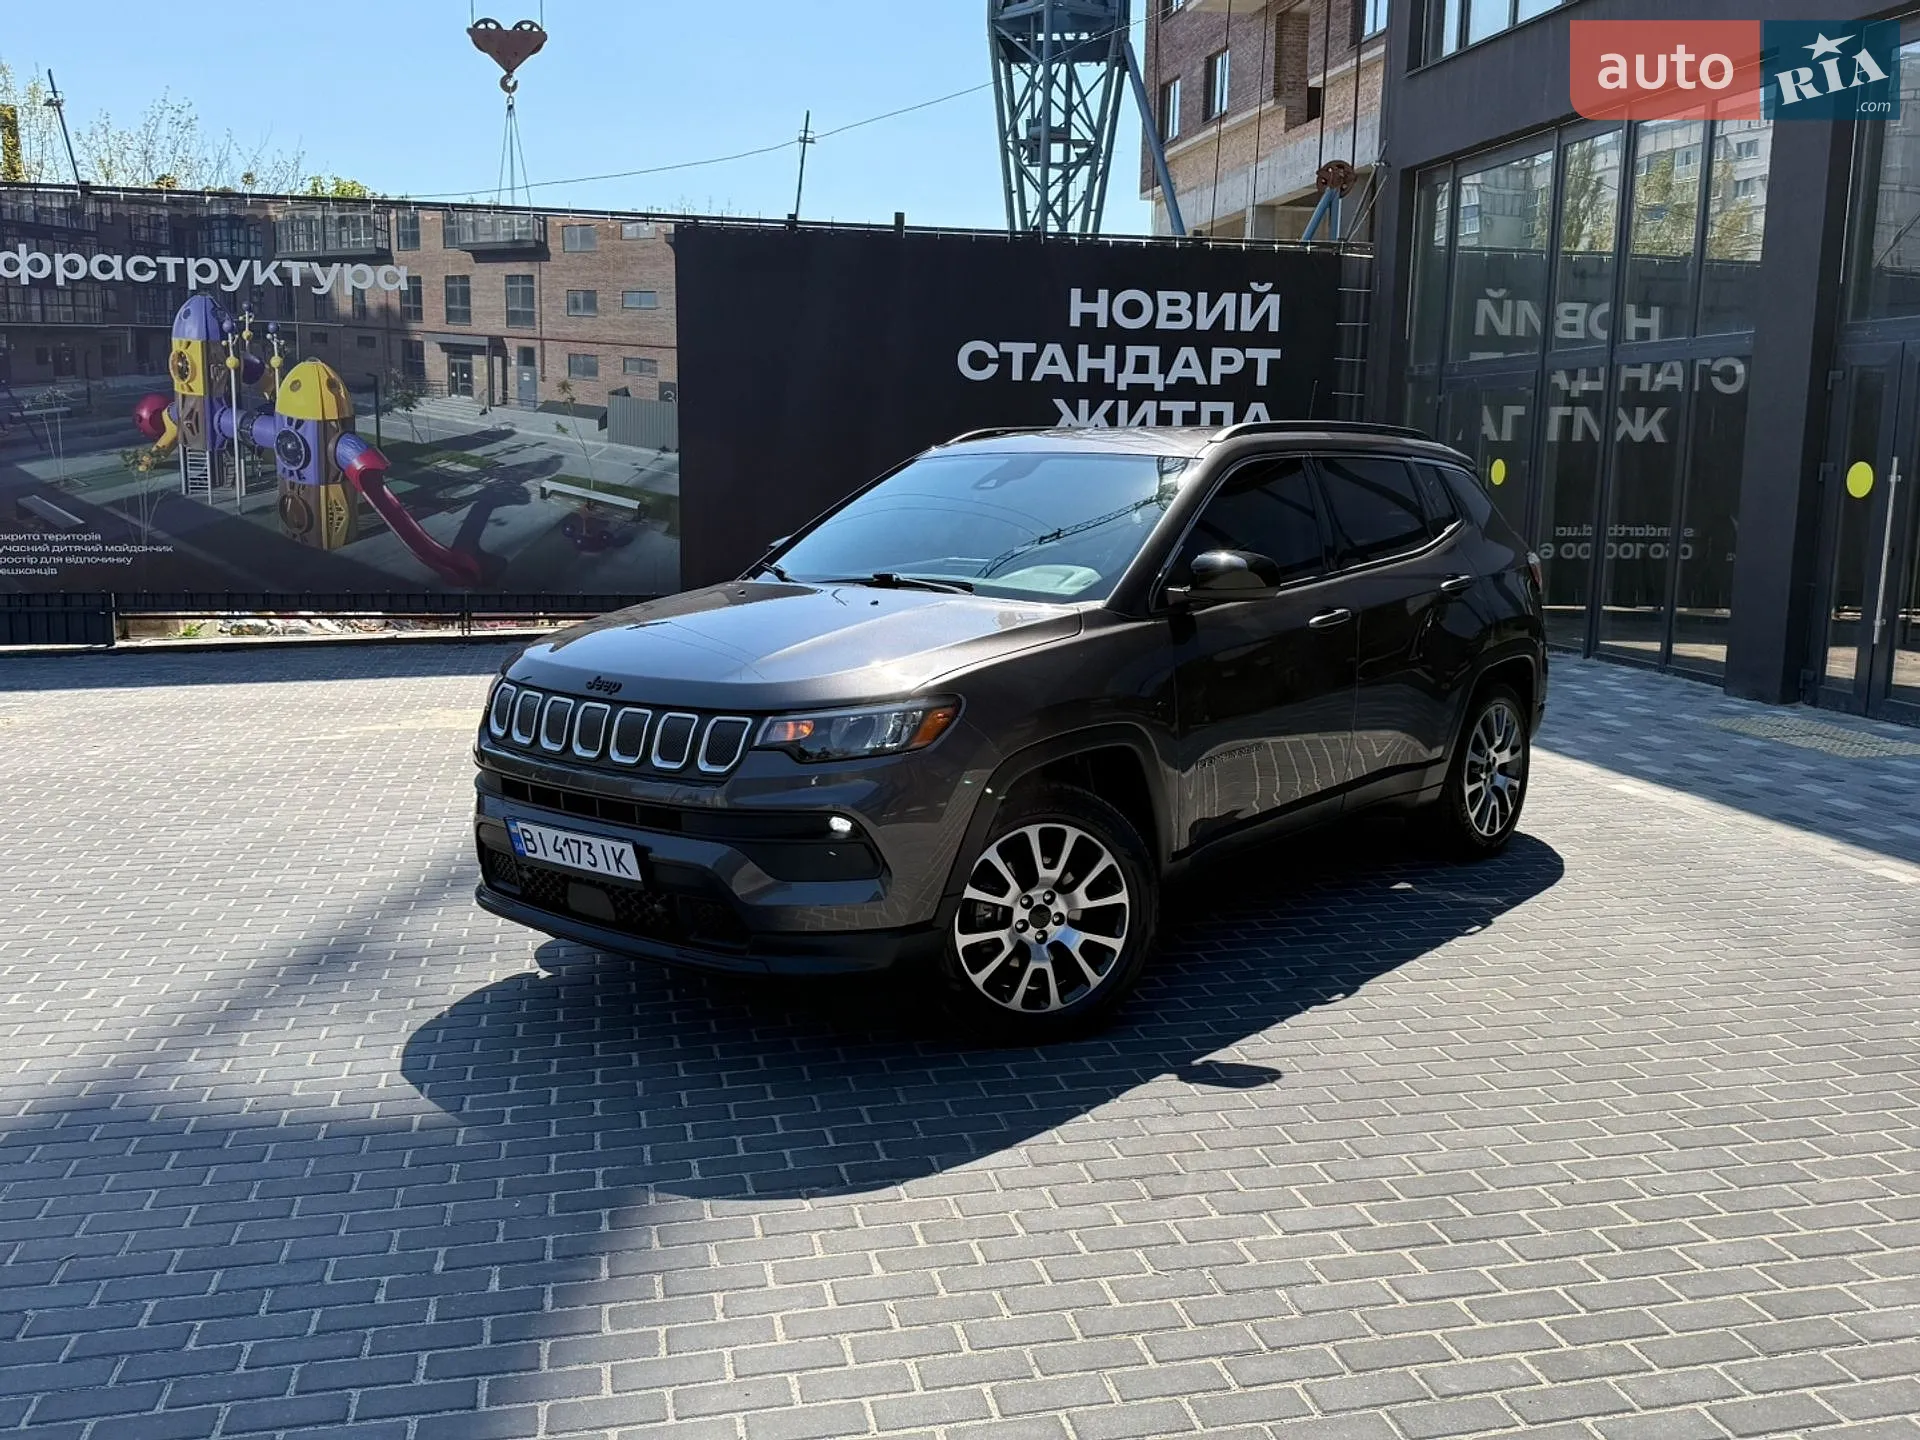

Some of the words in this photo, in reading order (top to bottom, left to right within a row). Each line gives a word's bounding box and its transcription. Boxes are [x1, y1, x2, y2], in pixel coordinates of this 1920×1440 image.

[0, 243, 409, 294] фраструктура
[1069, 282, 1281, 332] НОВИЙ
[957, 340, 1281, 391] СТАНДАРТ
[42, 532, 101, 542] територія
[51, 544, 102, 553] дитячий
[105, 544, 174, 553] майданчик
[39, 556, 64, 565] для
[65, 556, 133, 566] відпочинку
[585, 675, 623, 696] Jeep
[520, 827, 548, 857] BI
[552, 835, 598, 868] 4173
[600, 844, 632, 876] IK
